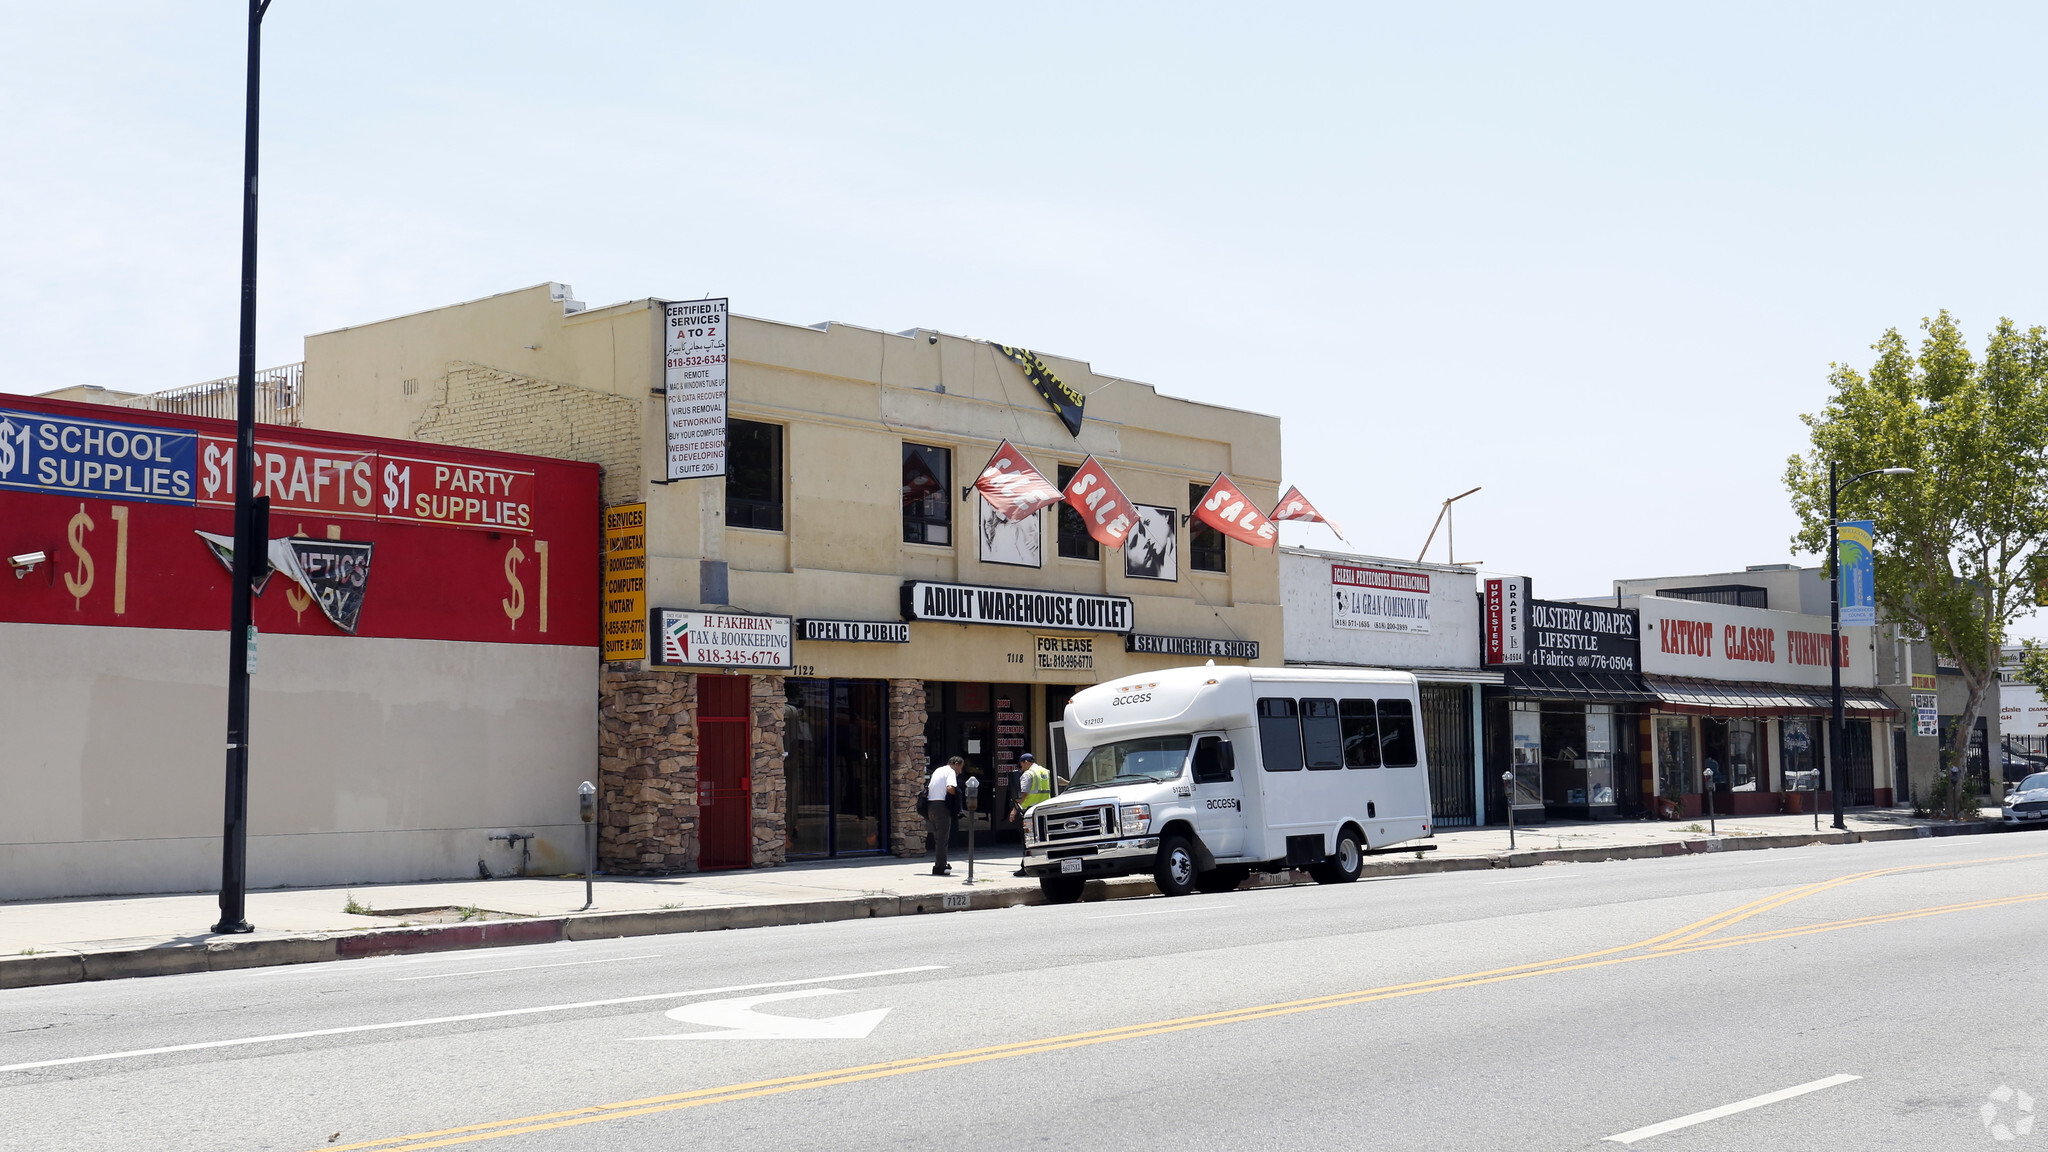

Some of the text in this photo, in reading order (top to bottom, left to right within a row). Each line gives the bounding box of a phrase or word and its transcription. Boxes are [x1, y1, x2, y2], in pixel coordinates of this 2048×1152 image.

[666, 303, 726, 317] CERTIFIED I.T.
[671, 314, 720, 327] SERVICES
[677, 327, 716, 339] A TO Z
[667, 354, 726, 368] 818-532-6343
[684, 370, 710, 380] REMOTE
[670, 382, 680, 390] MAC
[684, 380, 706, 389] WINDOWS
[668, 395, 677, 404] PC
[682, 393, 696, 402] DATA
[697, 391, 726, 401] RECOVERY
[671, 403, 722, 416] VIRUS REMOVAL
[673, 416, 722, 428] NETWORKING
[669, 427, 726, 440] BUY YOUR COMPUTER
[0, 418, 172, 479] $1 SCHOOL
[669, 440, 726, 452] WEBSITE DESIGN
[678, 450, 724, 461] DEVELOPING
[37, 456, 190, 497] SUPPLIES
[203, 442, 234, 498] $1
[383, 461, 514, 513] $1 PARTY
[415, 493, 530, 527] SUPPLIES
[1071, 473, 1131, 538] SALE
[607, 510, 643, 528] SERVICES
[1204, 489, 1277, 540] SALE
[609, 535, 643, 551] INCOMETAX
[609, 556, 644, 572] BOOKKEEPING
[1334, 568, 1354, 584] IGLESIA
[608, 577, 643, 594] COMPUTER
[608, 598, 634, 613] NOTARY
[923, 586, 1127, 628] ADULT WAREHOUSE OUTLET
[1351, 592, 1360, 614] LA
[1362, 594, 1381, 615] GRAN
[1383, 596, 1415, 618] COMISION
[704, 615, 772, 630] H. FAKHRIAN
[1490, 583, 1499, 652] UPHOLSTERY
[1584, 612, 1591, 630] &
[1592, 610, 1632, 635] DRAPES
[808, 621, 907, 641] OPEN TO PUBLIC
[606, 638, 642, 652] SUITE # 206
[690, 630, 788, 648] TAX & BOOKKEEPING
[1038, 637, 1093, 652] FOR LEASE
[1138, 636, 1256, 657] SEXY LINGERIE & SHOES
[1538, 631, 1598, 651] LIFESTYLE
[1660, 618, 1713, 657] KATKOT
[1724, 624, 1775, 664] CLASSIC
[698, 648, 780, 665] 818-345-6776
[1007, 652, 1024, 664] 7118
[1038, 655, 1093, 669] TEL: 818-996-6770
[1540, 649, 1574, 667] Fabrics
[1577, 656, 1590, 667] (818)
[1591, 655, 1633, 671] 776-0504
[793, 664, 815, 676] 7122
[1113, 693, 1151, 706] access
[1084, 717, 1104, 725] 512103
[1173, 785, 1189, 793] 512103
[1206, 798, 1236, 809] access
[947, 896, 967, 907] 7122
